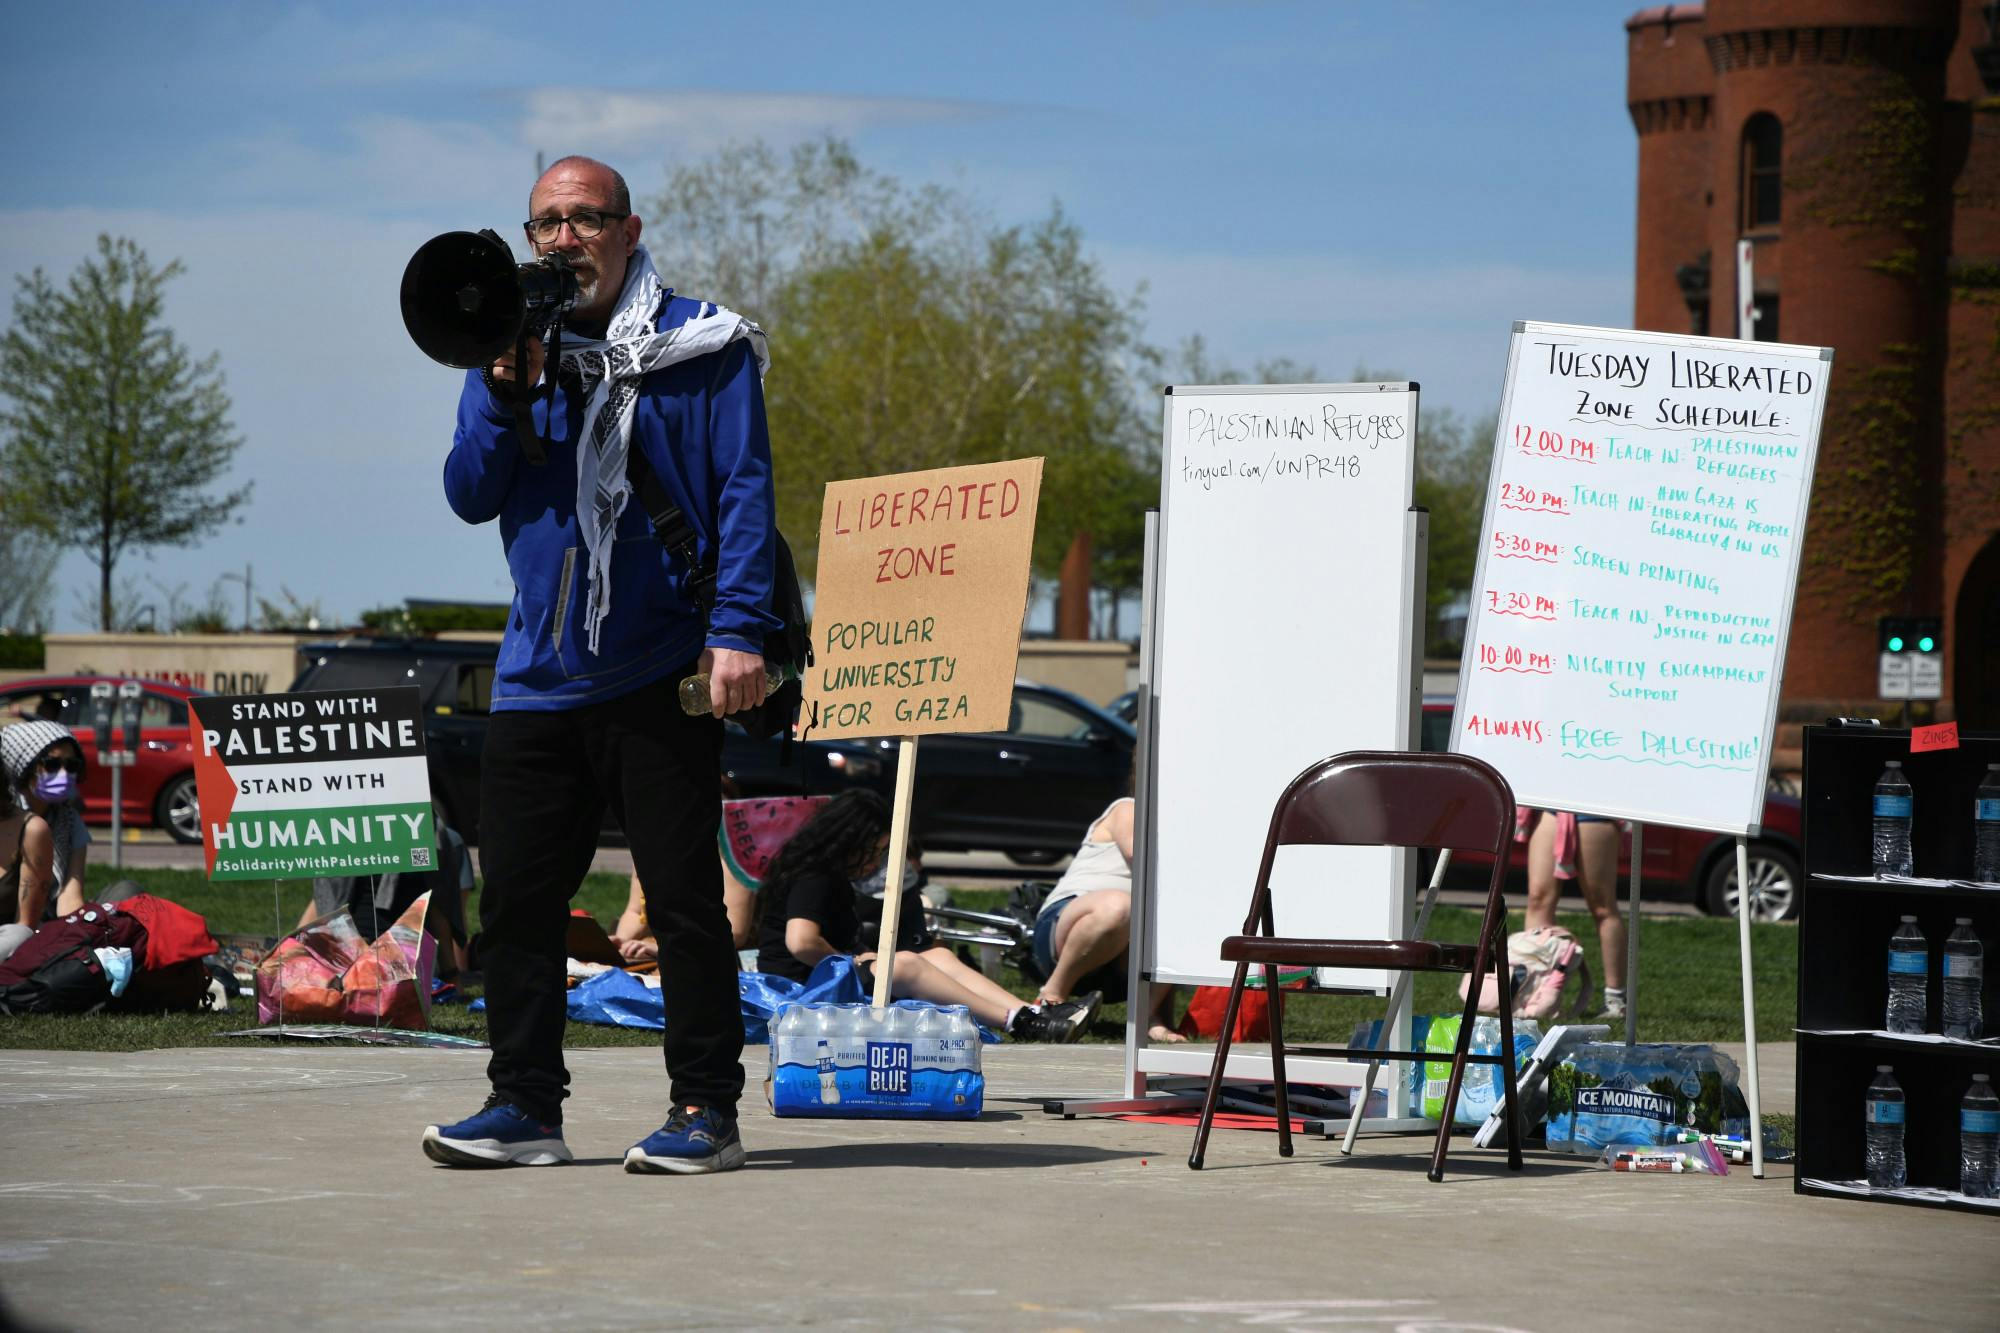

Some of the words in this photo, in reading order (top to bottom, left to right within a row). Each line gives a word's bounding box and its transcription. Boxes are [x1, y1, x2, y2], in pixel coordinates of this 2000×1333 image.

[1534, 342, 1650, 388] TUESDAY
[1671, 350, 1812, 395] LIBERATED
[1576, 390, 1635, 419] ZONE
[1656, 398, 1790, 428] SCHEDULE:
[1188, 408, 1314, 447] PALESTINIAN
[1605, 437, 1654, 463] TEACH
[1691, 437, 1799, 458] PALESTINIAN
[1696, 455, 1777, 484] REFUGEES
[835, 478, 1020, 535] LIBERATED
[1502, 483, 1535, 503] 2:30
[1542, 492, 1568, 509] PM:
[1571, 485, 1619, 511] TEACH
[1657, 486, 1689, 502] HOW
[1695, 486, 1736, 510] GAZA
[1746, 498, 1760, 514] IS
[1652, 505, 1738, 531] LIBERATING
[1747, 519, 1791, 537] PEOPLE
[1650, 520, 1719, 546] GLOBALLY
[1736, 539, 1752, 552] IN
[1761, 543, 1781, 558] US
[876, 543, 956, 583] ZONE
[1495, 532, 1530, 551] 5:30
[1573, 545, 1630, 576] SCREEN
[1639, 562, 1720, 594] PRINTING
[1486, 591, 1530, 609] 7:30
[1567, 598, 1620, 621] TEACH
[1665, 604, 1771, 628] REPRODUCTIVE
[827, 617, 934, 653] POPULAR
[1653, 623, 1709, 641] JUSTICE
[1718, 633, 1732, 645] IN
[1740, 632, 1775, 647] GAZA
[823, 656, 956, 692] UNIVERSITY
[1481, 644, 1522, 665] 10:00
[1529, 652, 1556, 669] PM:
[1567, 654, 1646, 681] NIGHTLY
[1659, 661, 1767, 683] ENCAMPMENT
[1609, 681, 1679, 701] SUPPORT
[232, 701, 305, 720] STAND
[315, 697, 377, 716] WITH
[823, 701, 872, 728] FOR
[895, 695, 968, 722] GAZA
[202, 719, 417, 757] PALESTINE
[1467, 714, 1551, 744] ALWAYS:
[1560, 721, 1624, 749] FREE
[1641, 730, 1759, 762] PALESTINE!
[1921, 729, 1956, 745] ZINES
[240, 777, 312, 794] STAND
[323, 773, 386, 791] WITH
[211, 812, 425, 850] HUMANITY
[215, 853, 400, 873] #SolidarityWithPalestine
[871, 1046, 907, 1068] DEJA
[940, 1040, 949, 1050] 24
[871, 1069, 907, 1092] BLUE
[1578, 1091, 1599, 1105] ICE
[1601, 1090, 1671, 1114] MOUNTAIN
